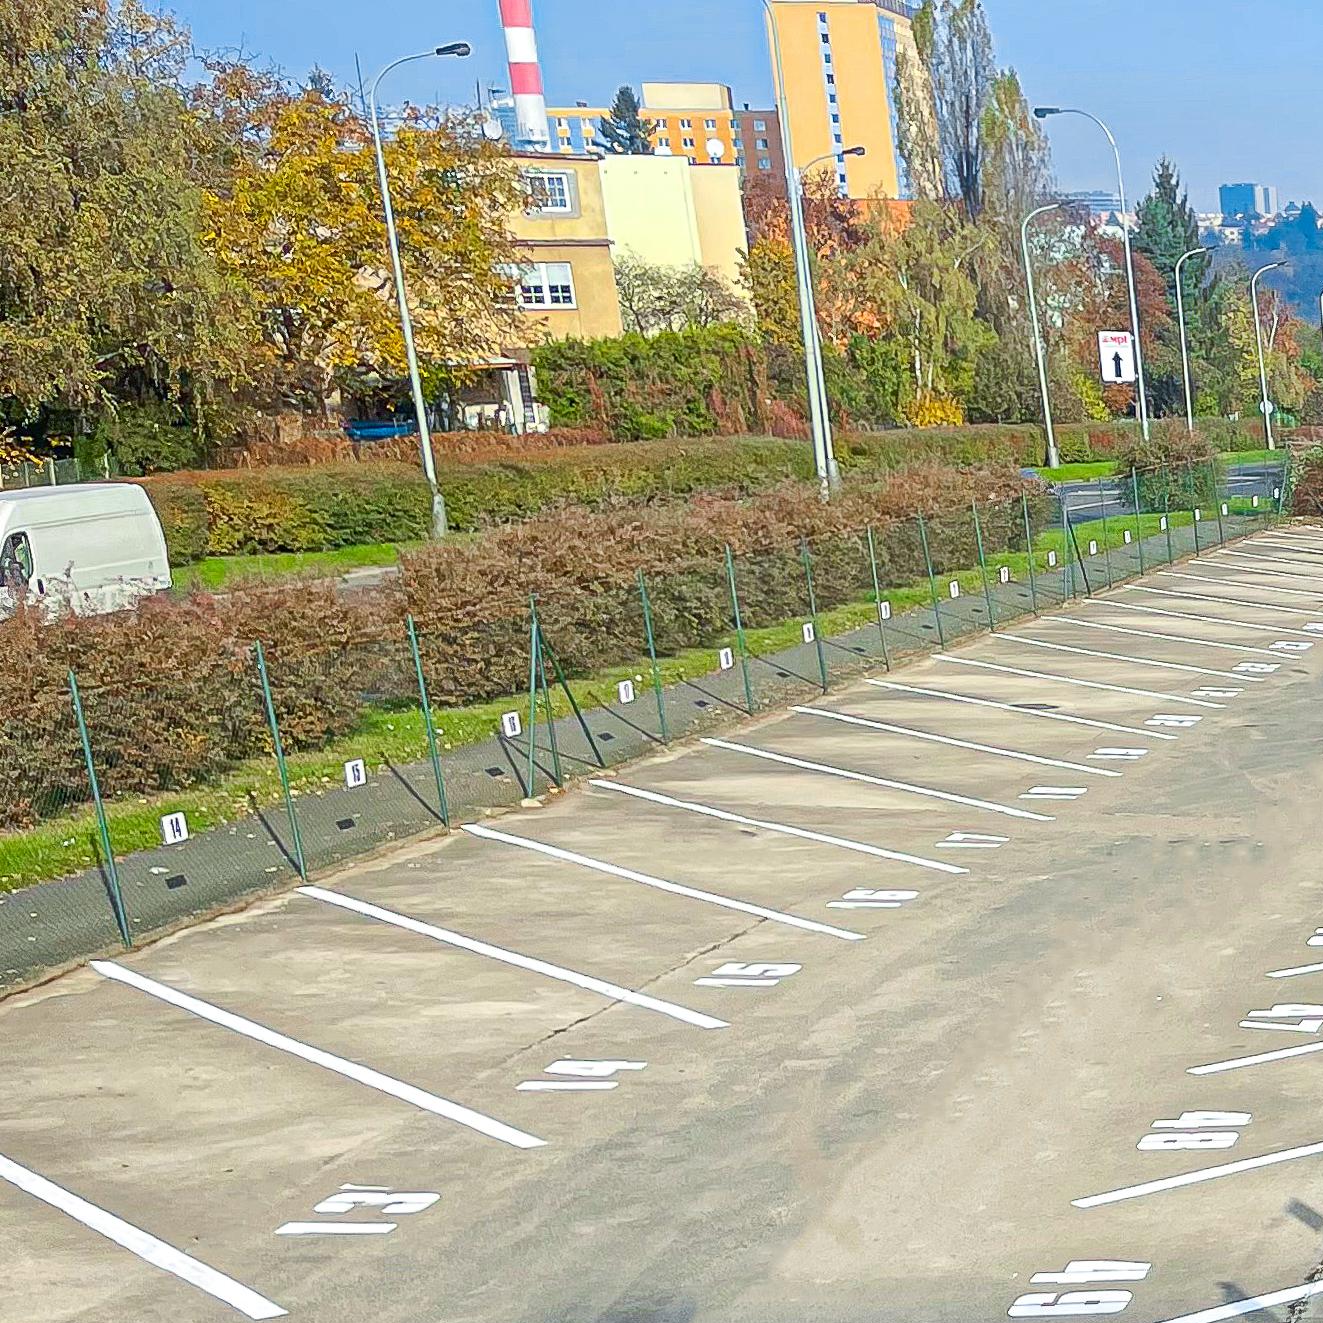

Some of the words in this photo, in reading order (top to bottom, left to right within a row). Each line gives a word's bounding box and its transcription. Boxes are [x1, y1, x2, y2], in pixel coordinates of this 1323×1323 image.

[350, 763, 360, 783] 15
[169, 817, 182, 841] 14
[936, 833, 1009, 847] 17
[826, 890, 919, 908] 16
[694, 964, 801, 987] 15
[516, 1061, 647, 1090] 14
[1137, 1112, 1252, 1149] 48
[275, 1193, 440, 1234] 13
[1008, 1261, 1151, 1316] 49
